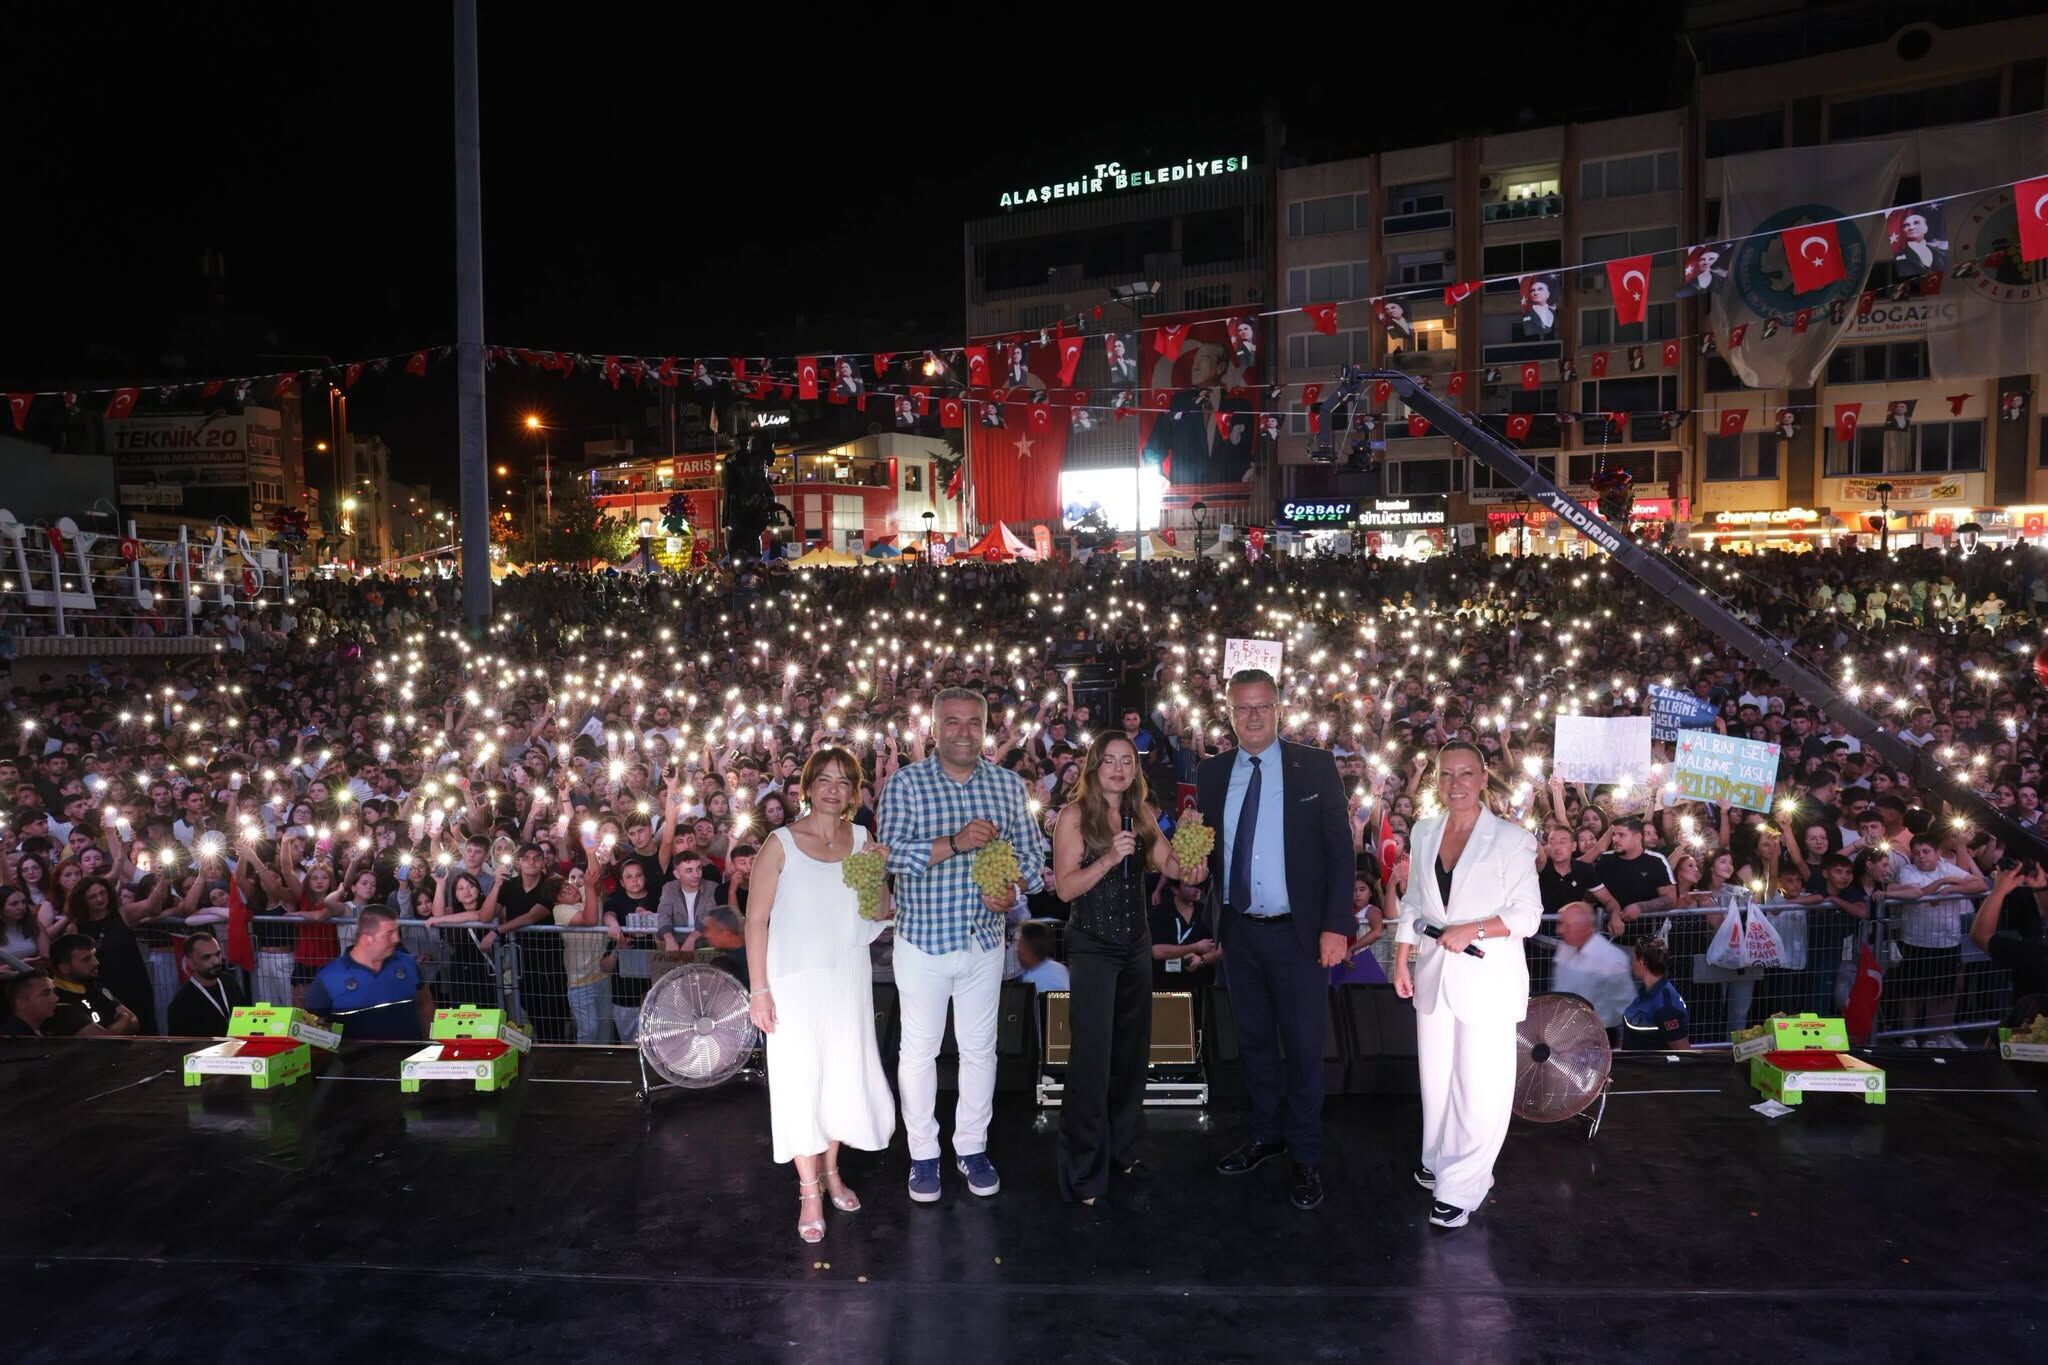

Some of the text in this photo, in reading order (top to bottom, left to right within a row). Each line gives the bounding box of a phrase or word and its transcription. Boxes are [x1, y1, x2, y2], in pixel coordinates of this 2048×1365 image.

[1095, 161, 1126, 179] T.C.
[999, 175, 1103, 208] ALAŞEHİR
[114, 425, 237, 449] TEKNİK 20
[675, 459, 712, 475] TARİŞ
[1359, 511, 1401, 525] SÜTLÜCE
[1549, 495, 1622, 553] YILDIRIM
